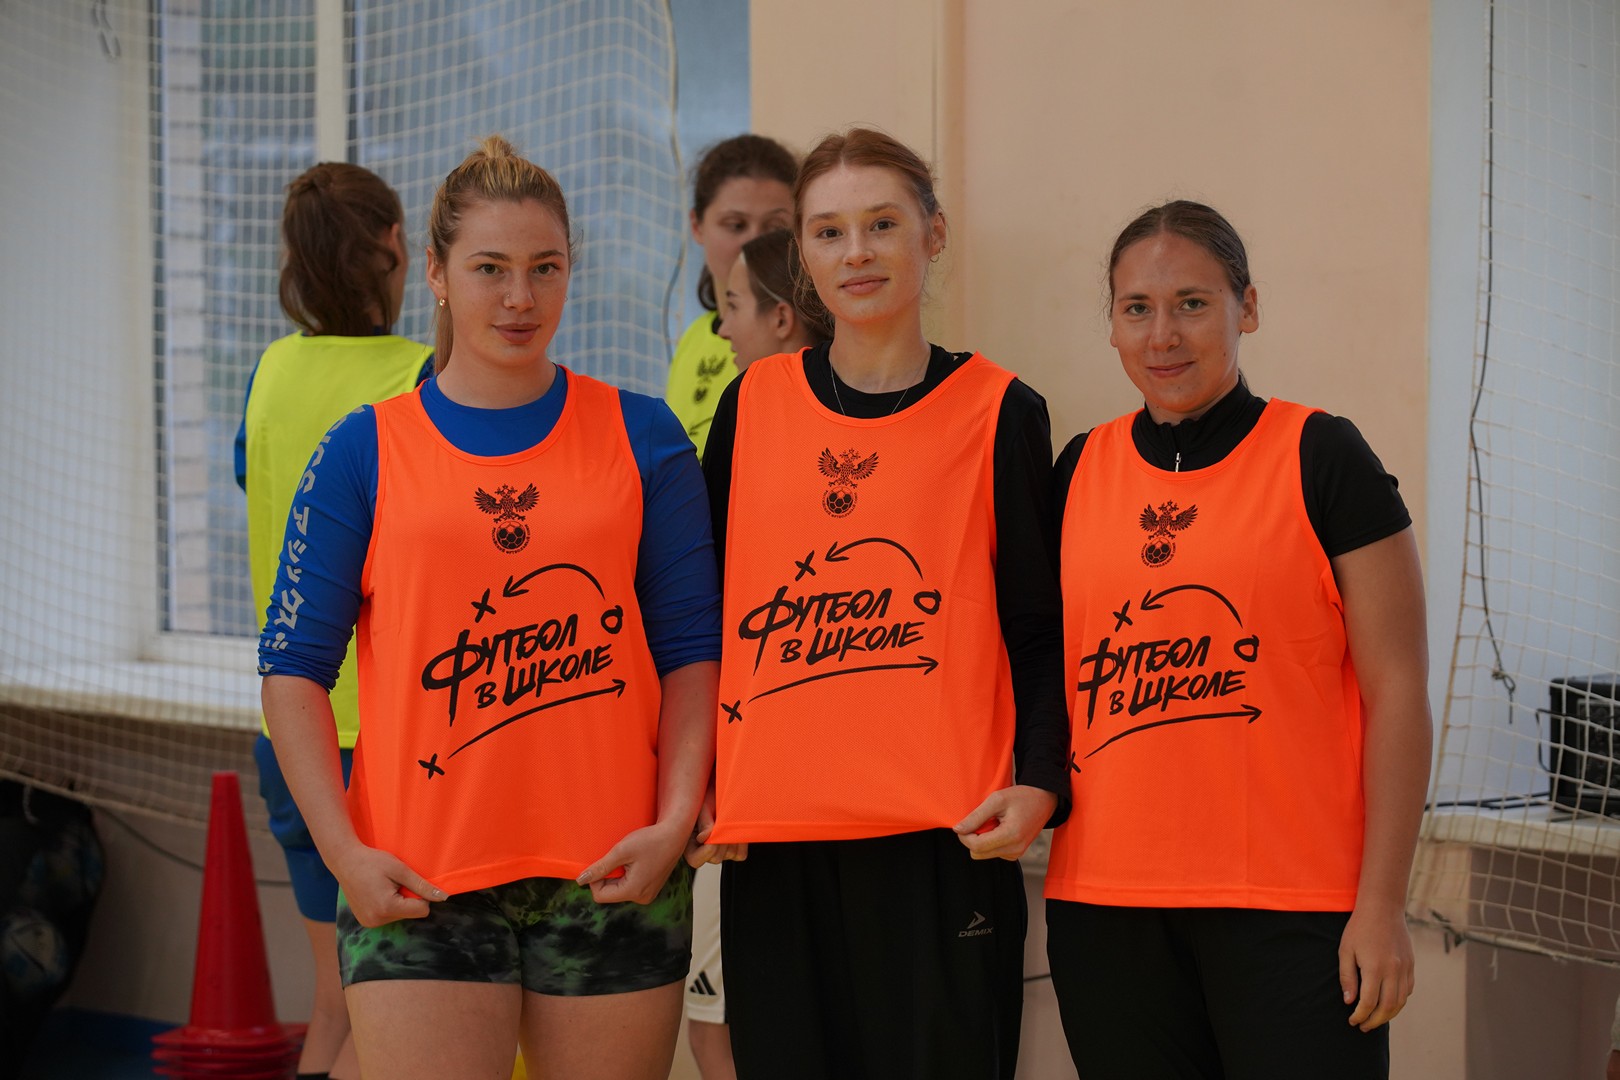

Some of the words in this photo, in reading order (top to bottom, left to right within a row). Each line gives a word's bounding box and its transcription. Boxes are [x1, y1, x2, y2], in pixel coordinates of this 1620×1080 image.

[737, 585, 893, 677] ФУТБОЛ
[805, 621, 925, 666] ШКОЛЕ
[421, 613, 579, 728] ФУТБОЛ
[501, 643, 614, 707] ШКОЛЕ
[1077, 635, 1212, 731] ФУТБОЛ
[1127, 669, 1247, 717] ШКОЛЕ
[957, 926, 994, 938] DEMIX
